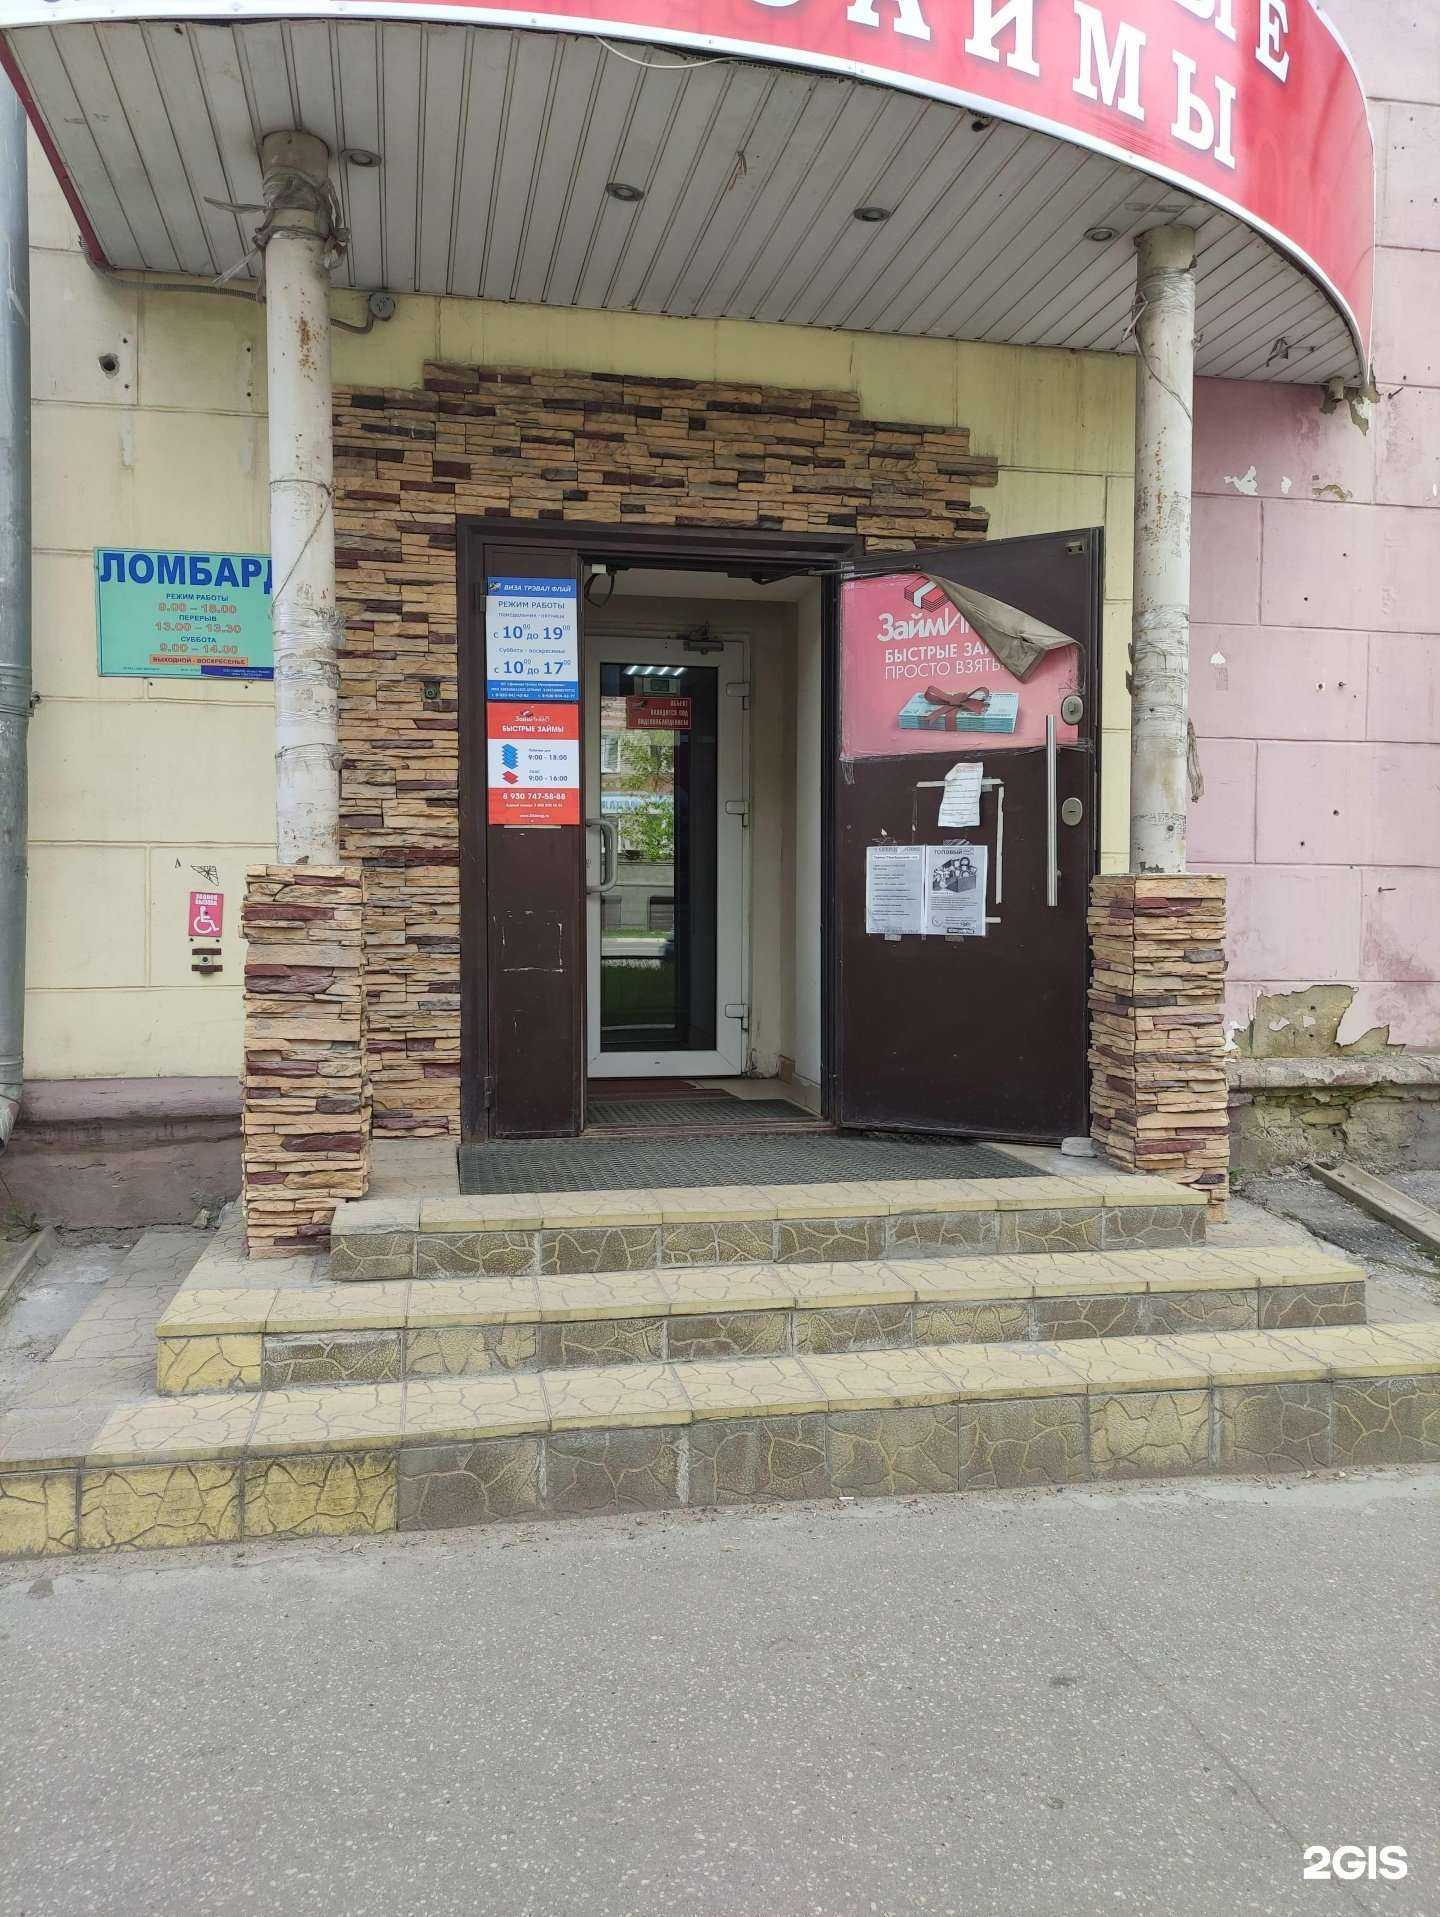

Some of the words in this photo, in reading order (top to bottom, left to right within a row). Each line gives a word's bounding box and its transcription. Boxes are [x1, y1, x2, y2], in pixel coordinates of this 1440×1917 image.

[166, 593, 195, 601] РЕЖИМ
[196, 594, 229, 602] РАБОТЫ
[532, 601, 565, 609] РАБОТЫ
[179, 614, 217, 622] ПЕРЕРЫВ
[885, 644, 958, 663] БЫСТРЫЕ
[152, 656, 192, 664] ВЫХОДНОЙ
[196, 657, 246, 665] ВОСКРЕСЕНЬЕ
[885, 661, 951, 680] ПРОСТО
[956, 657, 1005, 674] ВЗЯТЬ
[537, 724, 564, 733] ЗАЙМЫ
